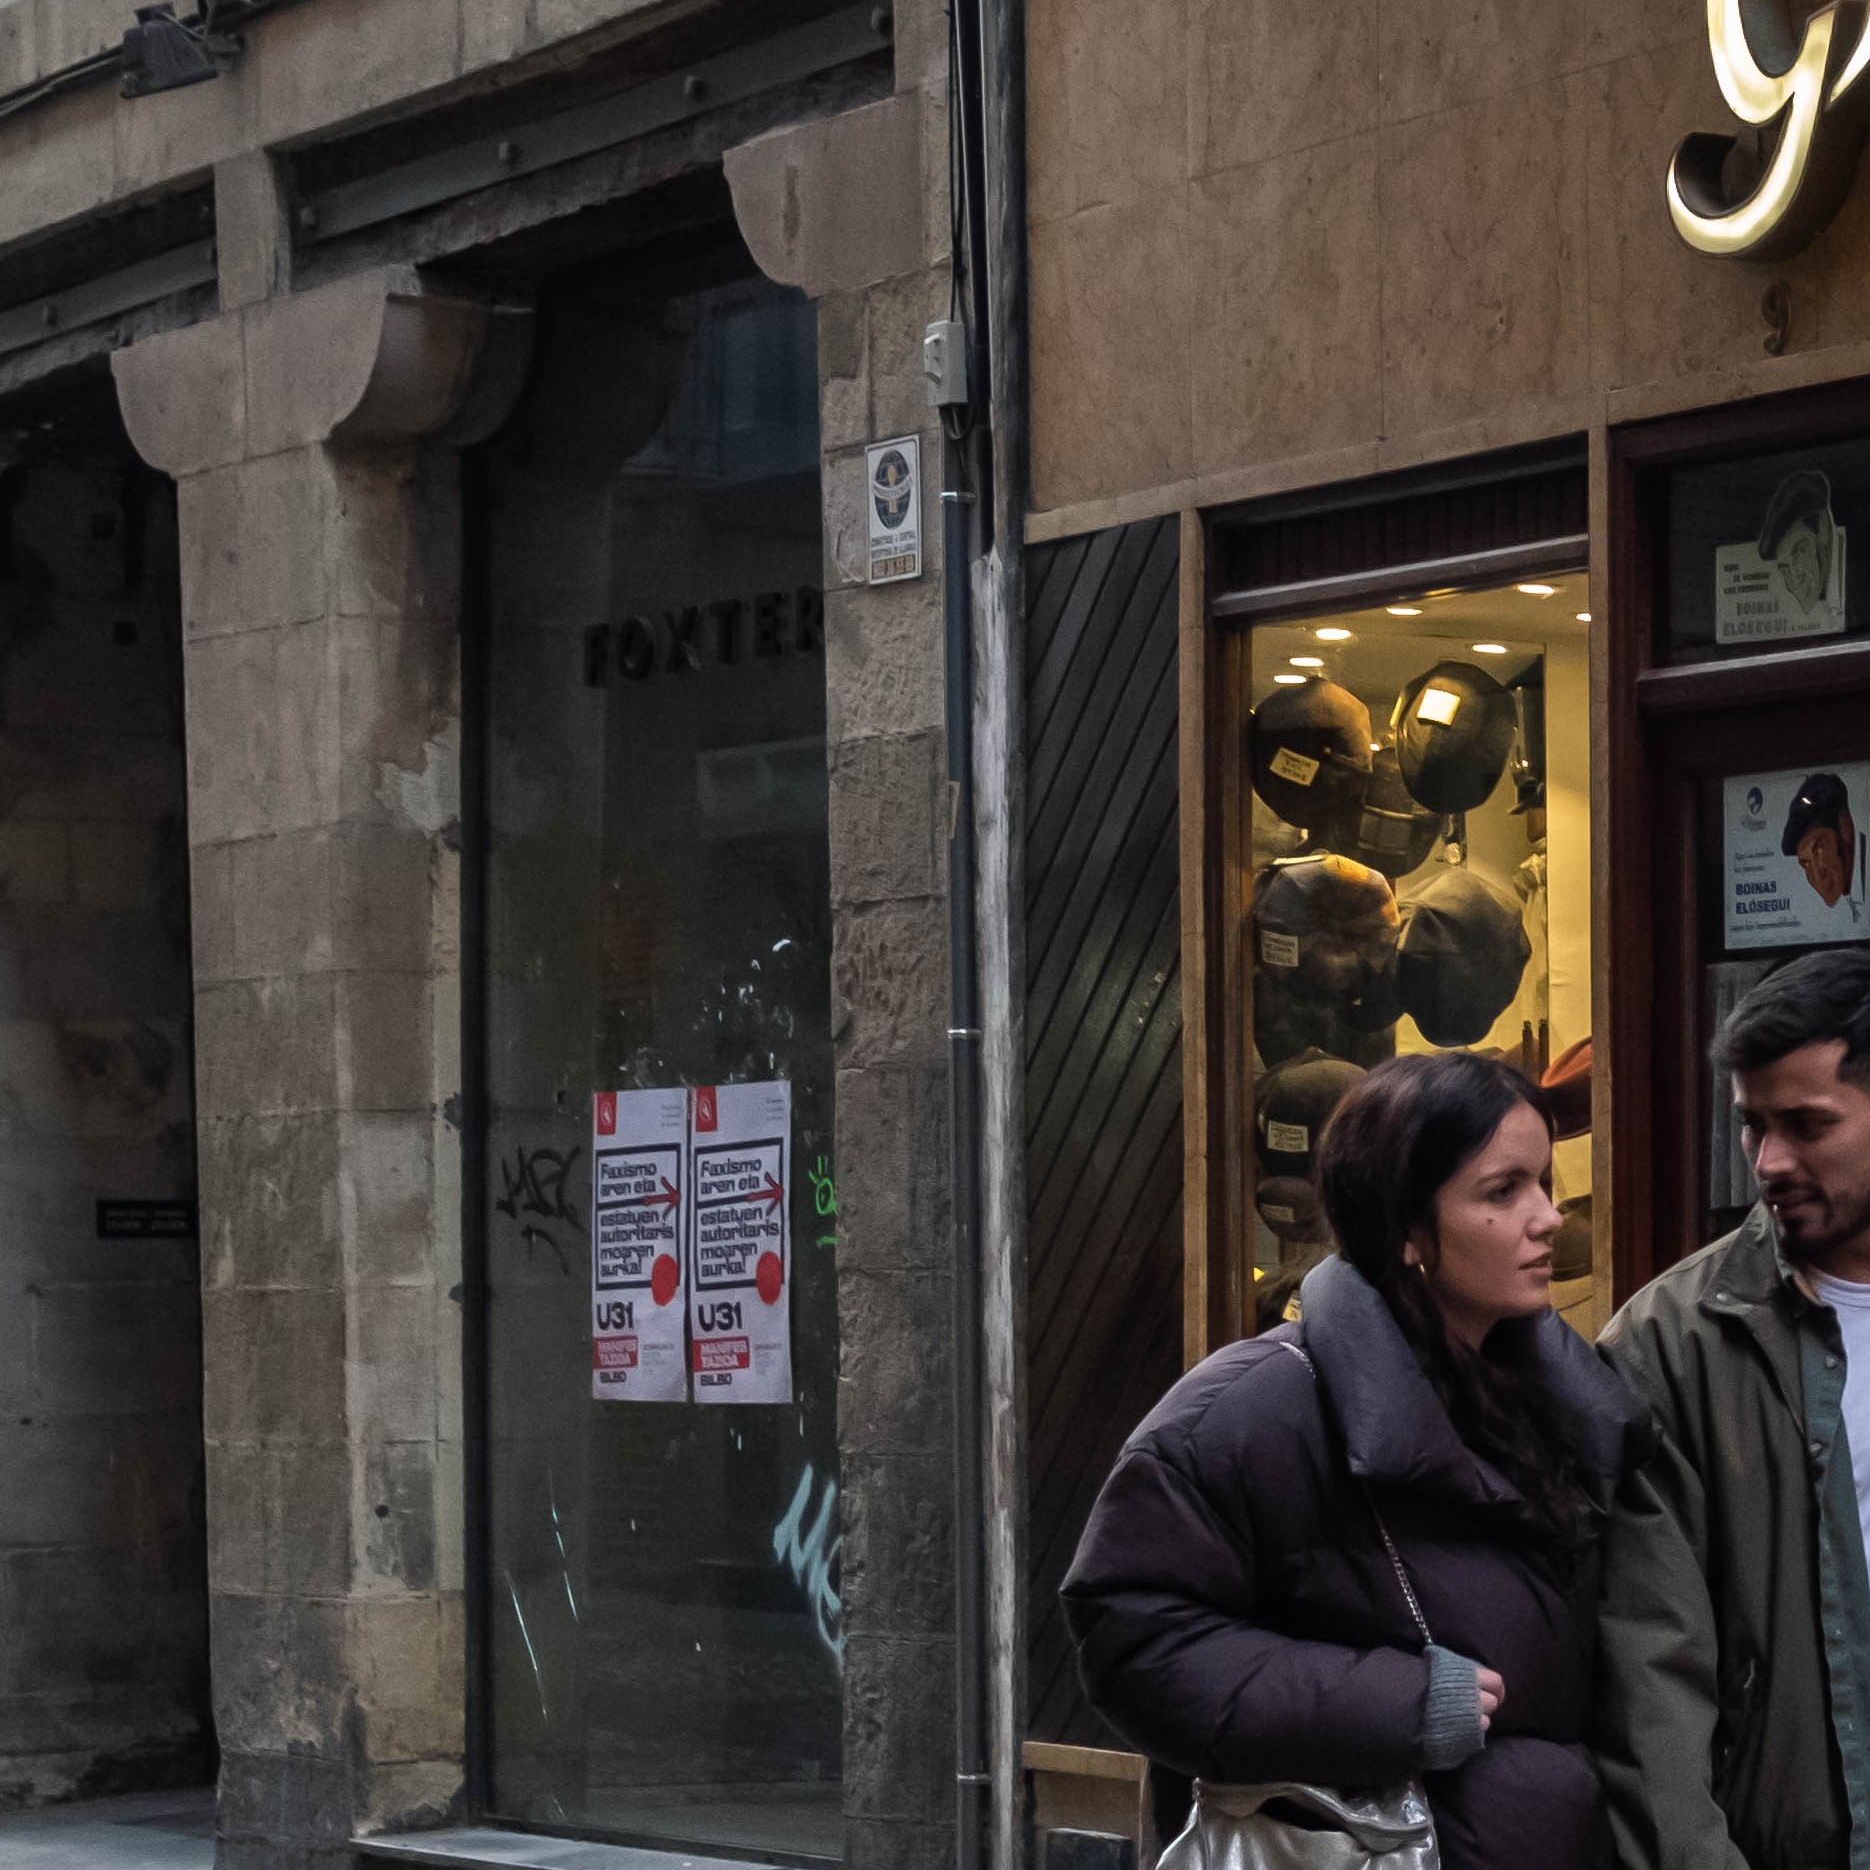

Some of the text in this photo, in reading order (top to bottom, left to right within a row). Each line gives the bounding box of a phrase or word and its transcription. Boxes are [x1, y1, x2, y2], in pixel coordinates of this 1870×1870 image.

[601, 1160, 657, 1180] Faxismo
[700, 1157, 762, 1178] Faxismo
[601, 1179, 656, 1197] aren eta
[701, 1175, 760, 1196] aren eta
[701, 1206, 763, 1226] estatuen
[601, 1224, 675, 1244] autoritaris
[701, 1220, 779, 1243] autoritaris
[701, 1243, 758, 1260] moaren
[701, 1257, 746, 1278] aurka!
[597, 1301, 634, 1331] U31
[698, 1301, 743, 1332] U31
[600, 1370, 627, 1384] BILBO
[700, 1373, 733, 1387] BILBO
